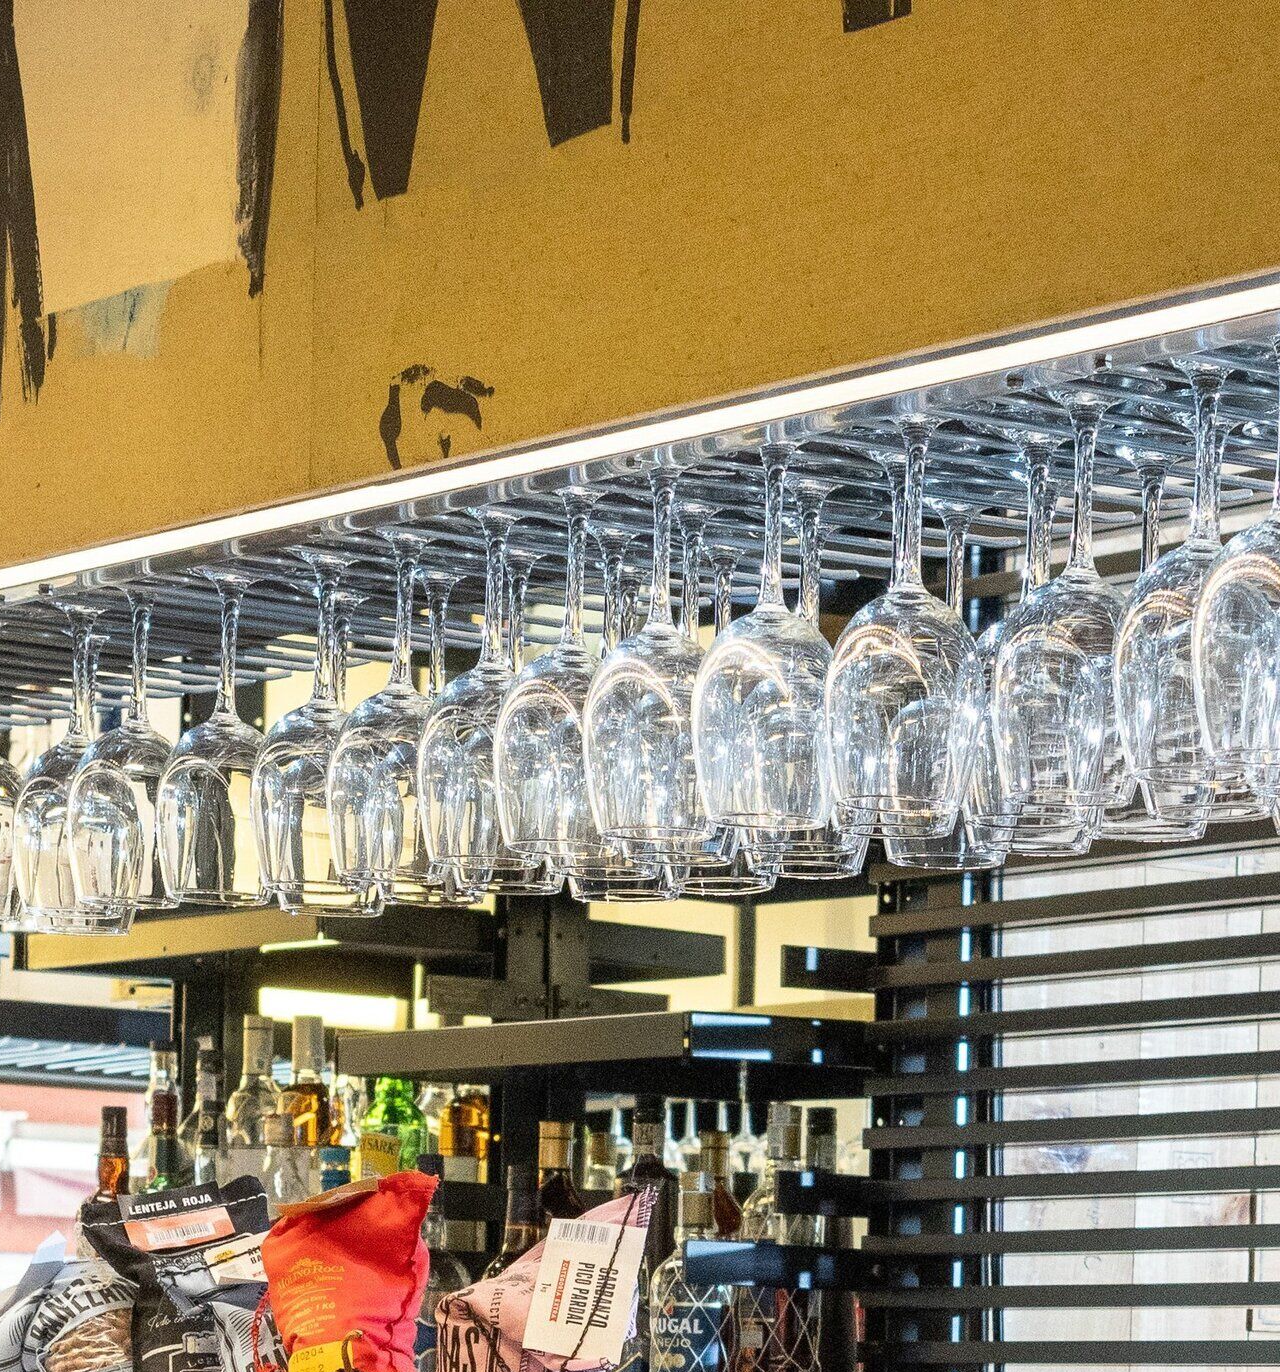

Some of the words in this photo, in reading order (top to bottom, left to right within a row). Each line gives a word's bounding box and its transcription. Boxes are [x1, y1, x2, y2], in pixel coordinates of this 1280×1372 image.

[128, 1197, 178, 1216] LENTEJA
[183, 1193, 213, 1208] ROJA
[574, 1261, 596, 1286] PICO
[565, 1287, 590, 1326] PARDAL
